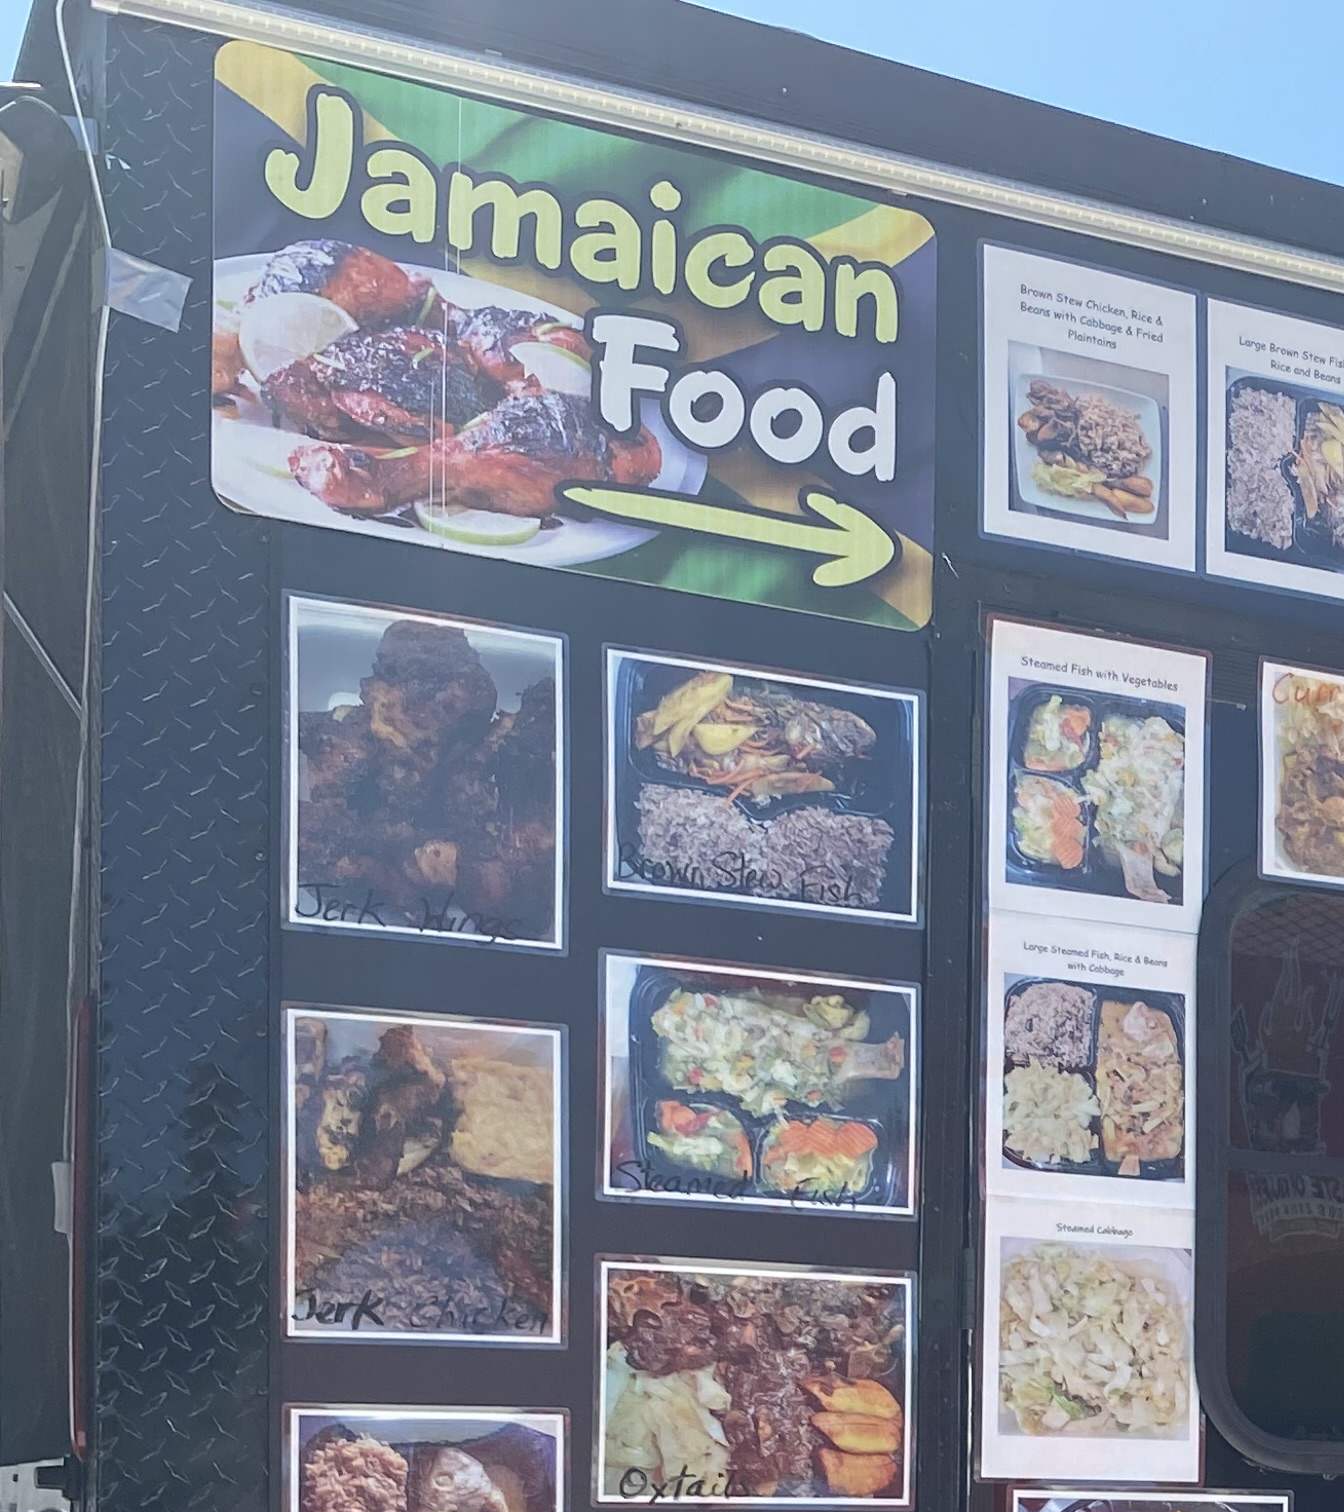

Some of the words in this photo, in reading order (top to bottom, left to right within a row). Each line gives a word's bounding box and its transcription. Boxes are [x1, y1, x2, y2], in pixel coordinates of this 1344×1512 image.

[265, 85, 900, 344] Jamaican
[1020, 284, 1053, 302] Brown
[1056, 291, 1084, 307] Stew
[1086, 299, 1129, 320] Chicken,
[1132, 305, 1154, 322] Rice
[1020, 301, 1052, 318] Beans
[1053, 307, 1078, 322] with
[1079, 312, 1125, 337] Cabbage
[1137, 327, 1165, 344] Fried
[1239, 334, 1267, 353] Large
[1269, 343, 1299, 361] Brown
[1301, 349, 1326, 364] Stew
[1270, 359, 1291, 373] Rice
[1292, 365, 1312, 378] and
[1313, 368, 1341, 384] Beans
[592, 313, 897, 482] Food
[1021, 655, 1069, 673] Steamed
[1070, 663, 1094, 677] Fish
[1096, 669, 1119, 682] with
[1121, 674, 1178, 693] Vegetables
[714, 850, 786, 895] Stew
[798, 868, 865, 905] Fish
[290, 1288, 382, 1327] Jerk
